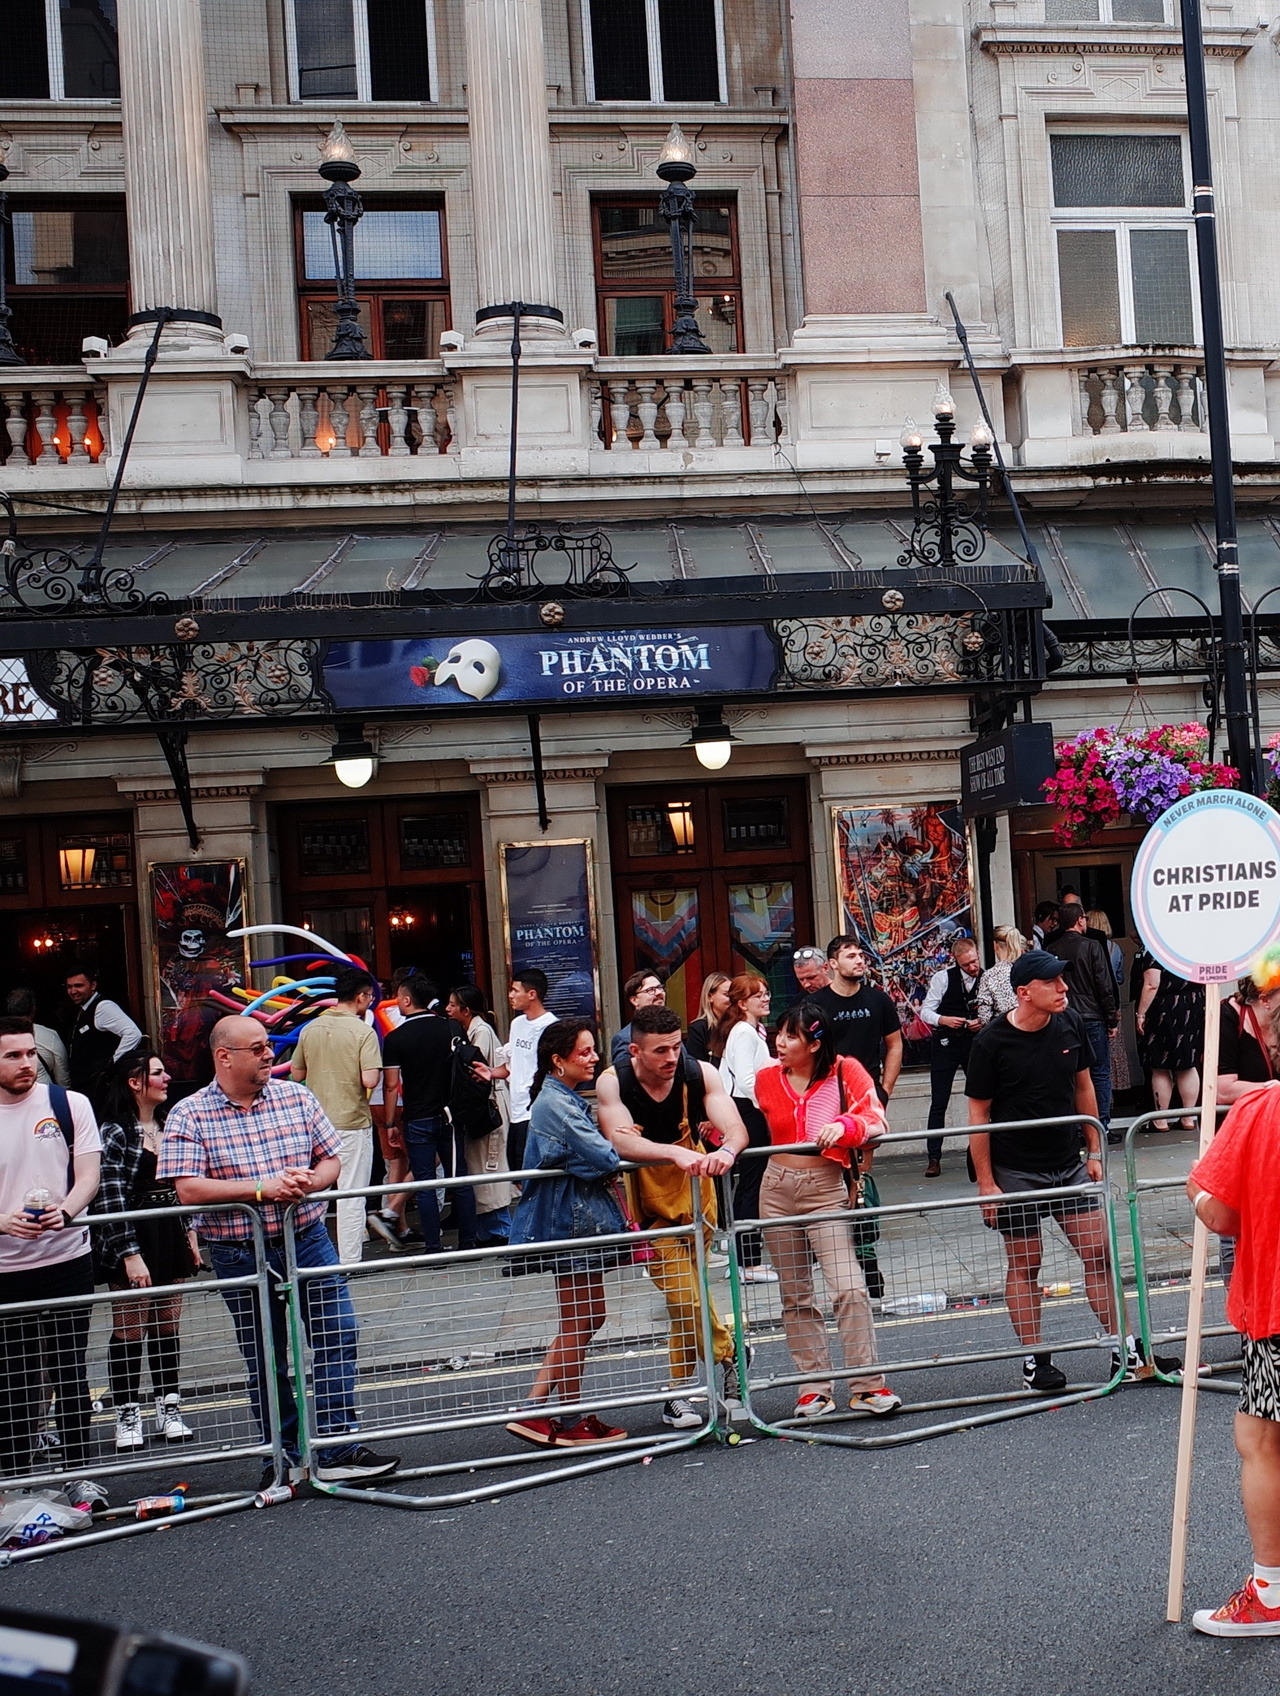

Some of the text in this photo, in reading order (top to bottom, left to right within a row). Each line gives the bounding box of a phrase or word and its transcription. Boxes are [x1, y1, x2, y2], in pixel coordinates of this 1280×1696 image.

[567, 632, 682, 644] ANDREW LLOYD WEBBER'S
[539, 643, 712, 676] PHANTOM
[562, 676, 692, 694] OF THE OPERA
[1162, 794, 1267, 828] NEVER MARCH ALONE
[1153, 860, 1277, 887] CHRISTIANS
[1168, 890, 1260, 914] AT PRIDE
[516, 925, 585, 941] PHANTOM
[1199, 965, 1228, 975] PRIDE
[516, 1038, 532, 1050] BOSS
